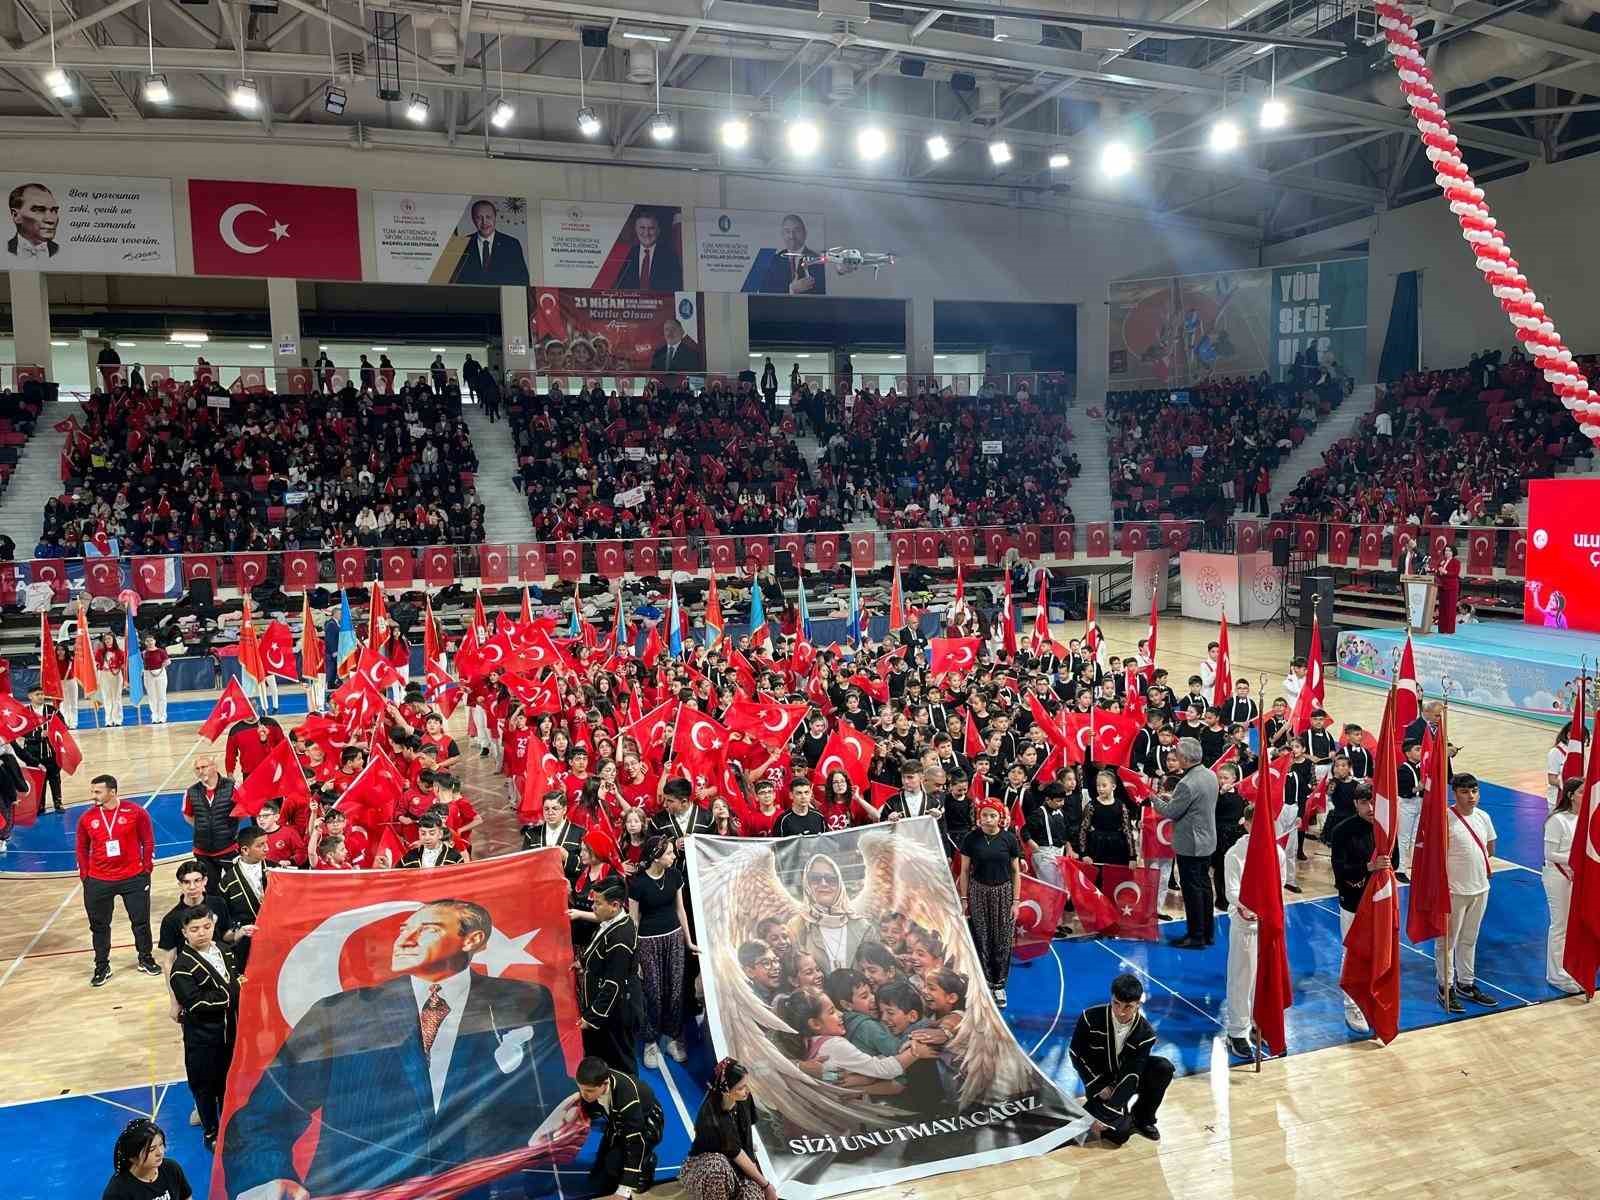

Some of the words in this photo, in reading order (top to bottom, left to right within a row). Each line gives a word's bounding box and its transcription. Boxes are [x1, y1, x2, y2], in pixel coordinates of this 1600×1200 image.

[590, 310, 619, 319] Kutlu
[622, 310, 654, 319] Olsun
[830, 815, 848, 830] 23
[788, 1134, 838, 1156] SİZİ
[840, 1095, 1043, 1151] UNUTMAYACAĞIZ
